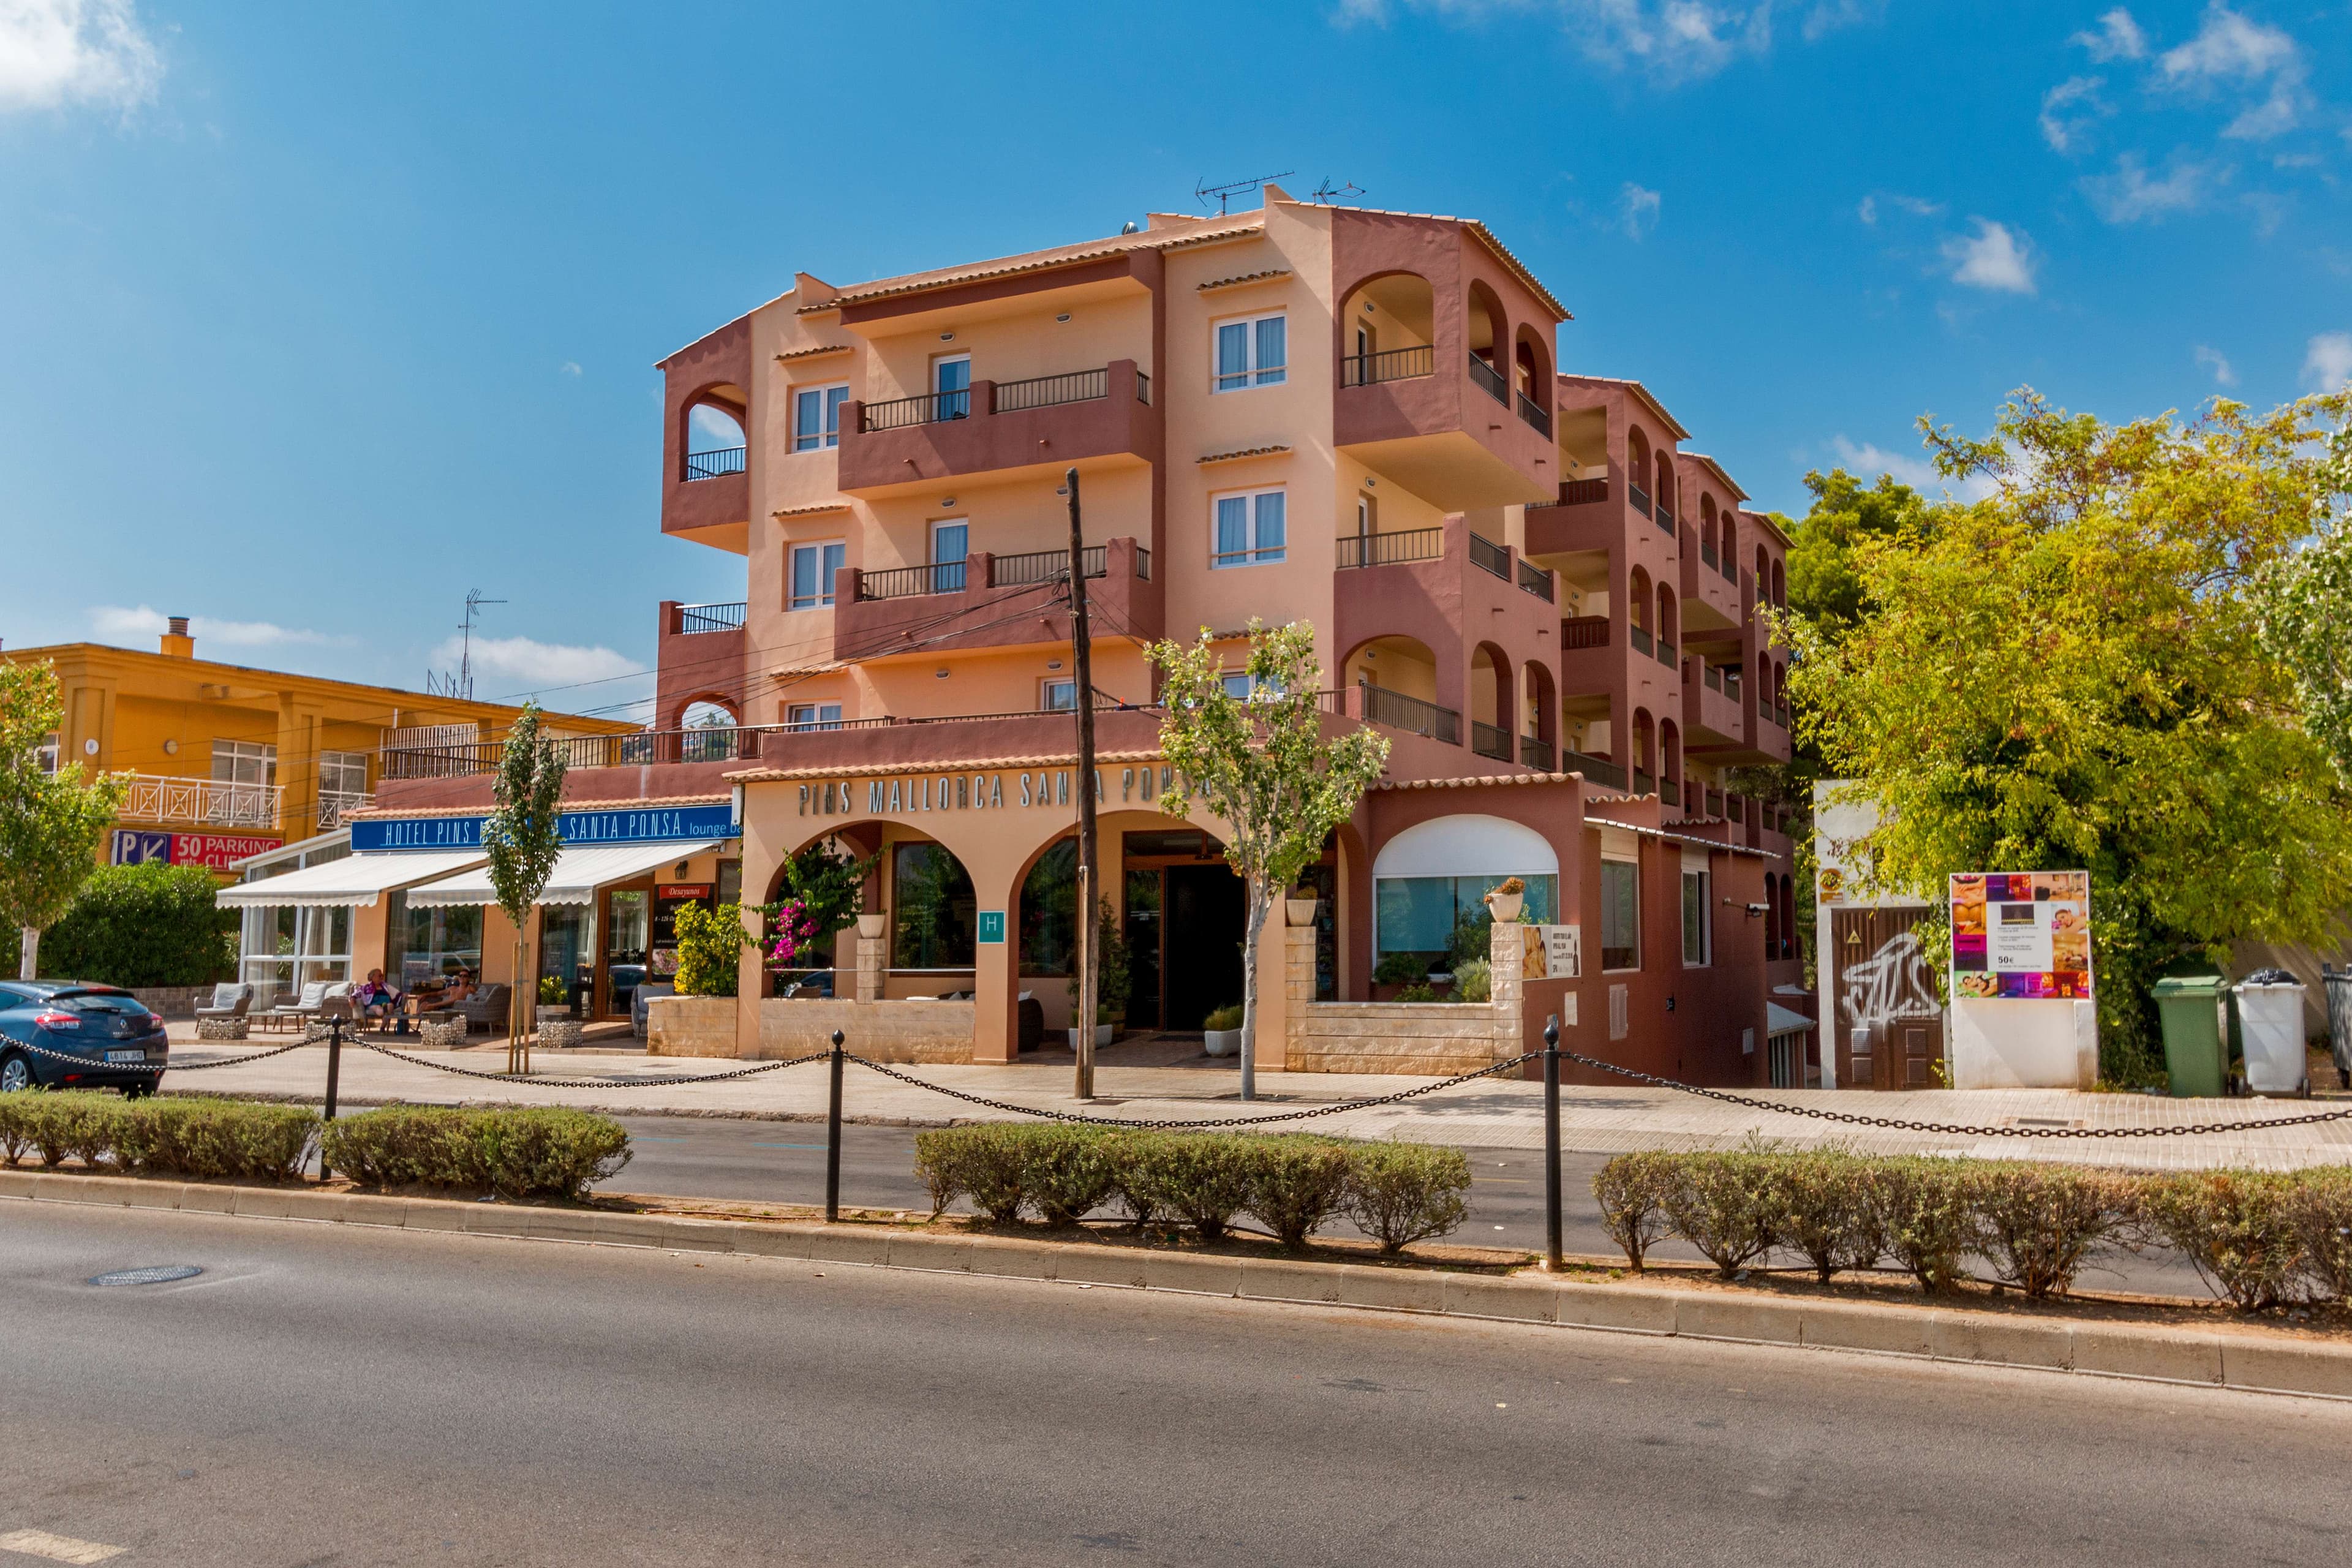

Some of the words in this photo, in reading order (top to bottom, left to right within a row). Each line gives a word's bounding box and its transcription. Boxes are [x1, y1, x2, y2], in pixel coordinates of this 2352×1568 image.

[799, 782, 853, 816] PINS
[868, 774, 1003, 814] MALLORCA
[1020, 770, 1104, 807] SANA
[385, 823, 428, 845] HOTEL
[437, 821, 470, 843] PINS
[569, 815, 618, 840] SANTA
[629, 812, 681, 837] PONSA
[689, 823, 726, 837] lounge
[178, 836, 202, 858] 50
[668, 888, 700, 898] Desayunos
[986, 916, 997, 932] H
